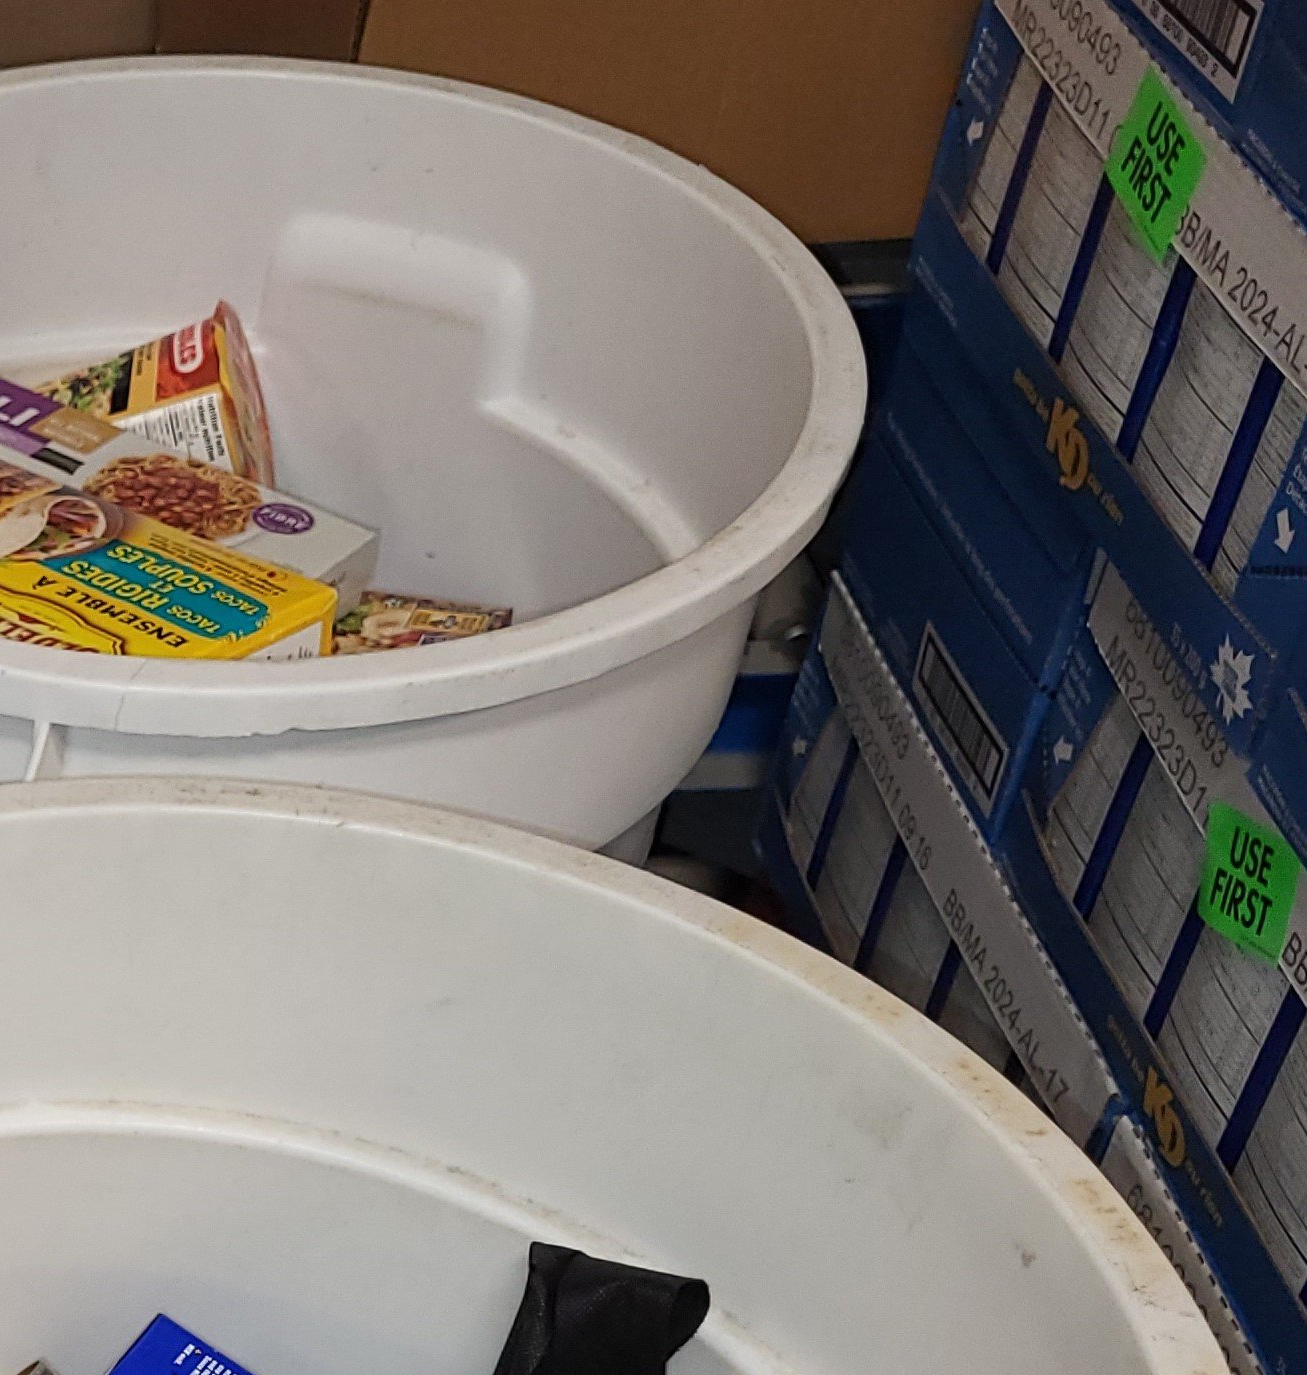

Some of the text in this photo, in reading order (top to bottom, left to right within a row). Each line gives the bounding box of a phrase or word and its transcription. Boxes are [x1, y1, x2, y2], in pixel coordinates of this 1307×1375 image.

[1146, 101, 1186, 177] USE
[1120, 135, 1172, 224] FIRST
[61, 560, 170, 610] RIGIDES
[107, 545, 215, 595] SOUPLES
[55, 585, 189, 649] ENSEMBLE
[166, 605, 222, 634] TACOS
[1230, 826, 1275, 888] USE
[1209, 867, 1274, 937] FIRST
